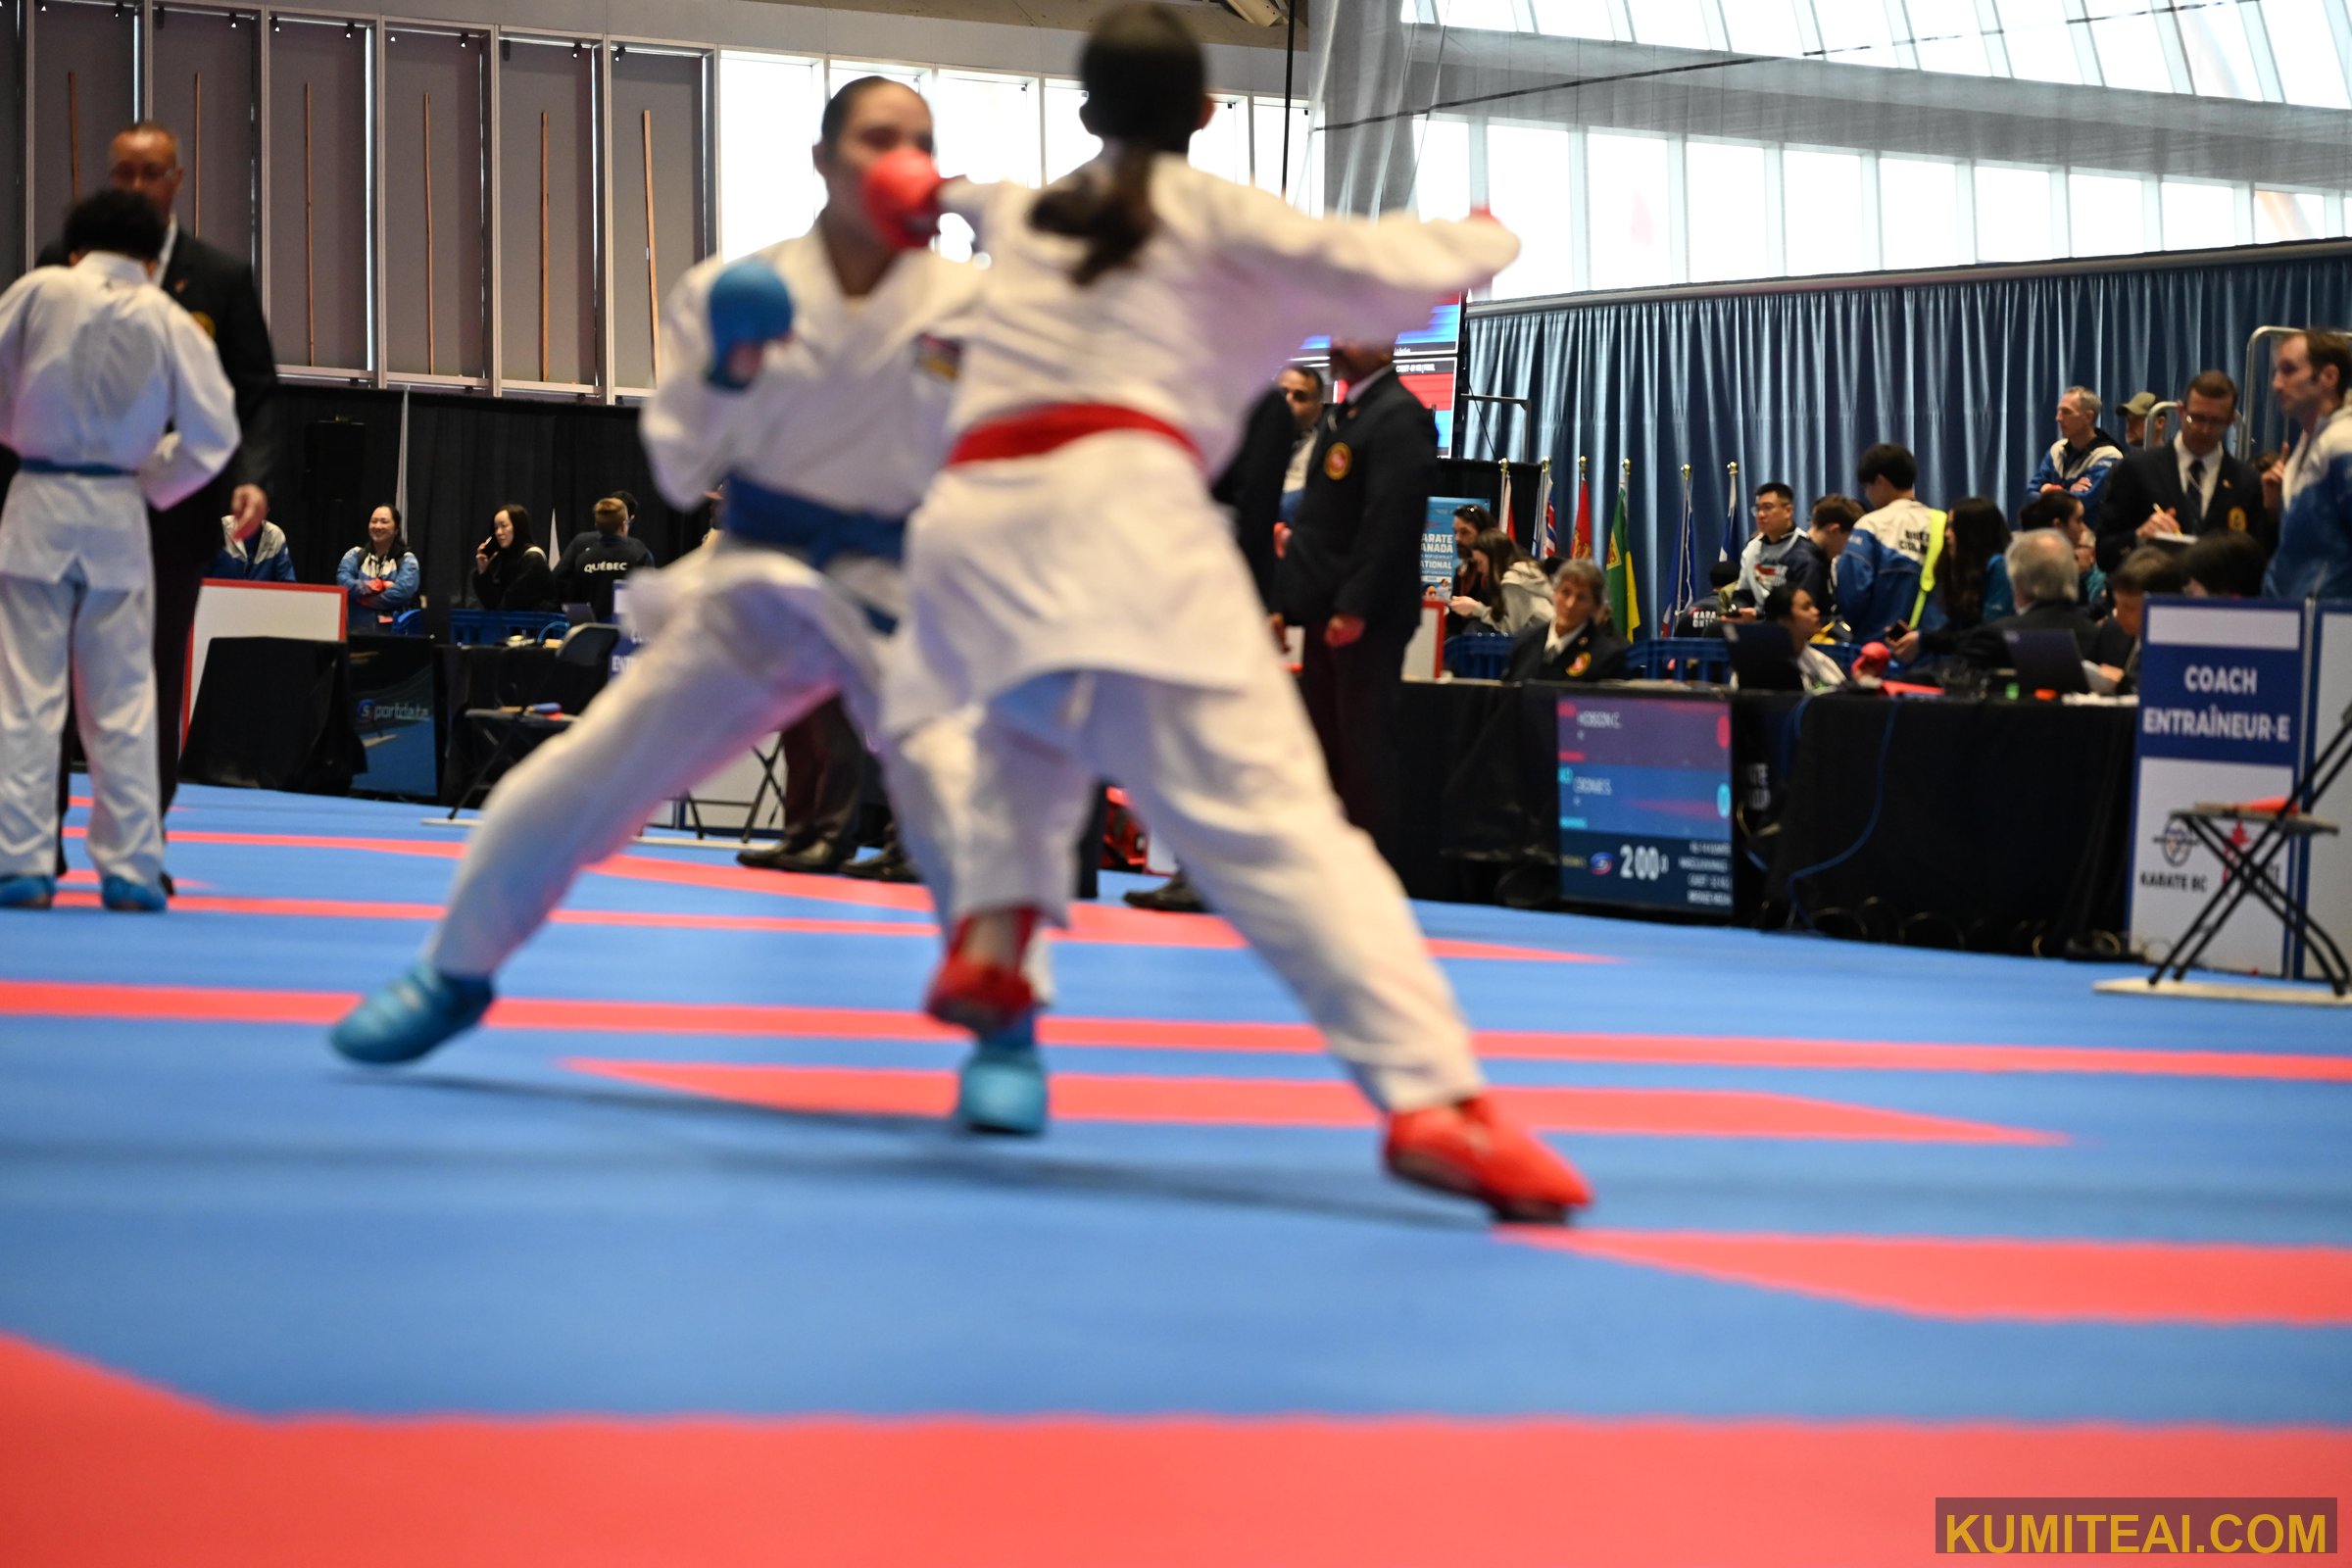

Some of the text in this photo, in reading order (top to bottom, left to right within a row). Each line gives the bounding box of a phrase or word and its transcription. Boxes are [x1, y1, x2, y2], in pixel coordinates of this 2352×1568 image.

[1421, 533, 1452, 543] ARATE
[1421, 543, 1452, 553] ANADA
[584, 562, 627, 572] QUÉBEC
[2184, 664, 2258, 695] COACH
[2140, 871, 2187, 891] KARATE
